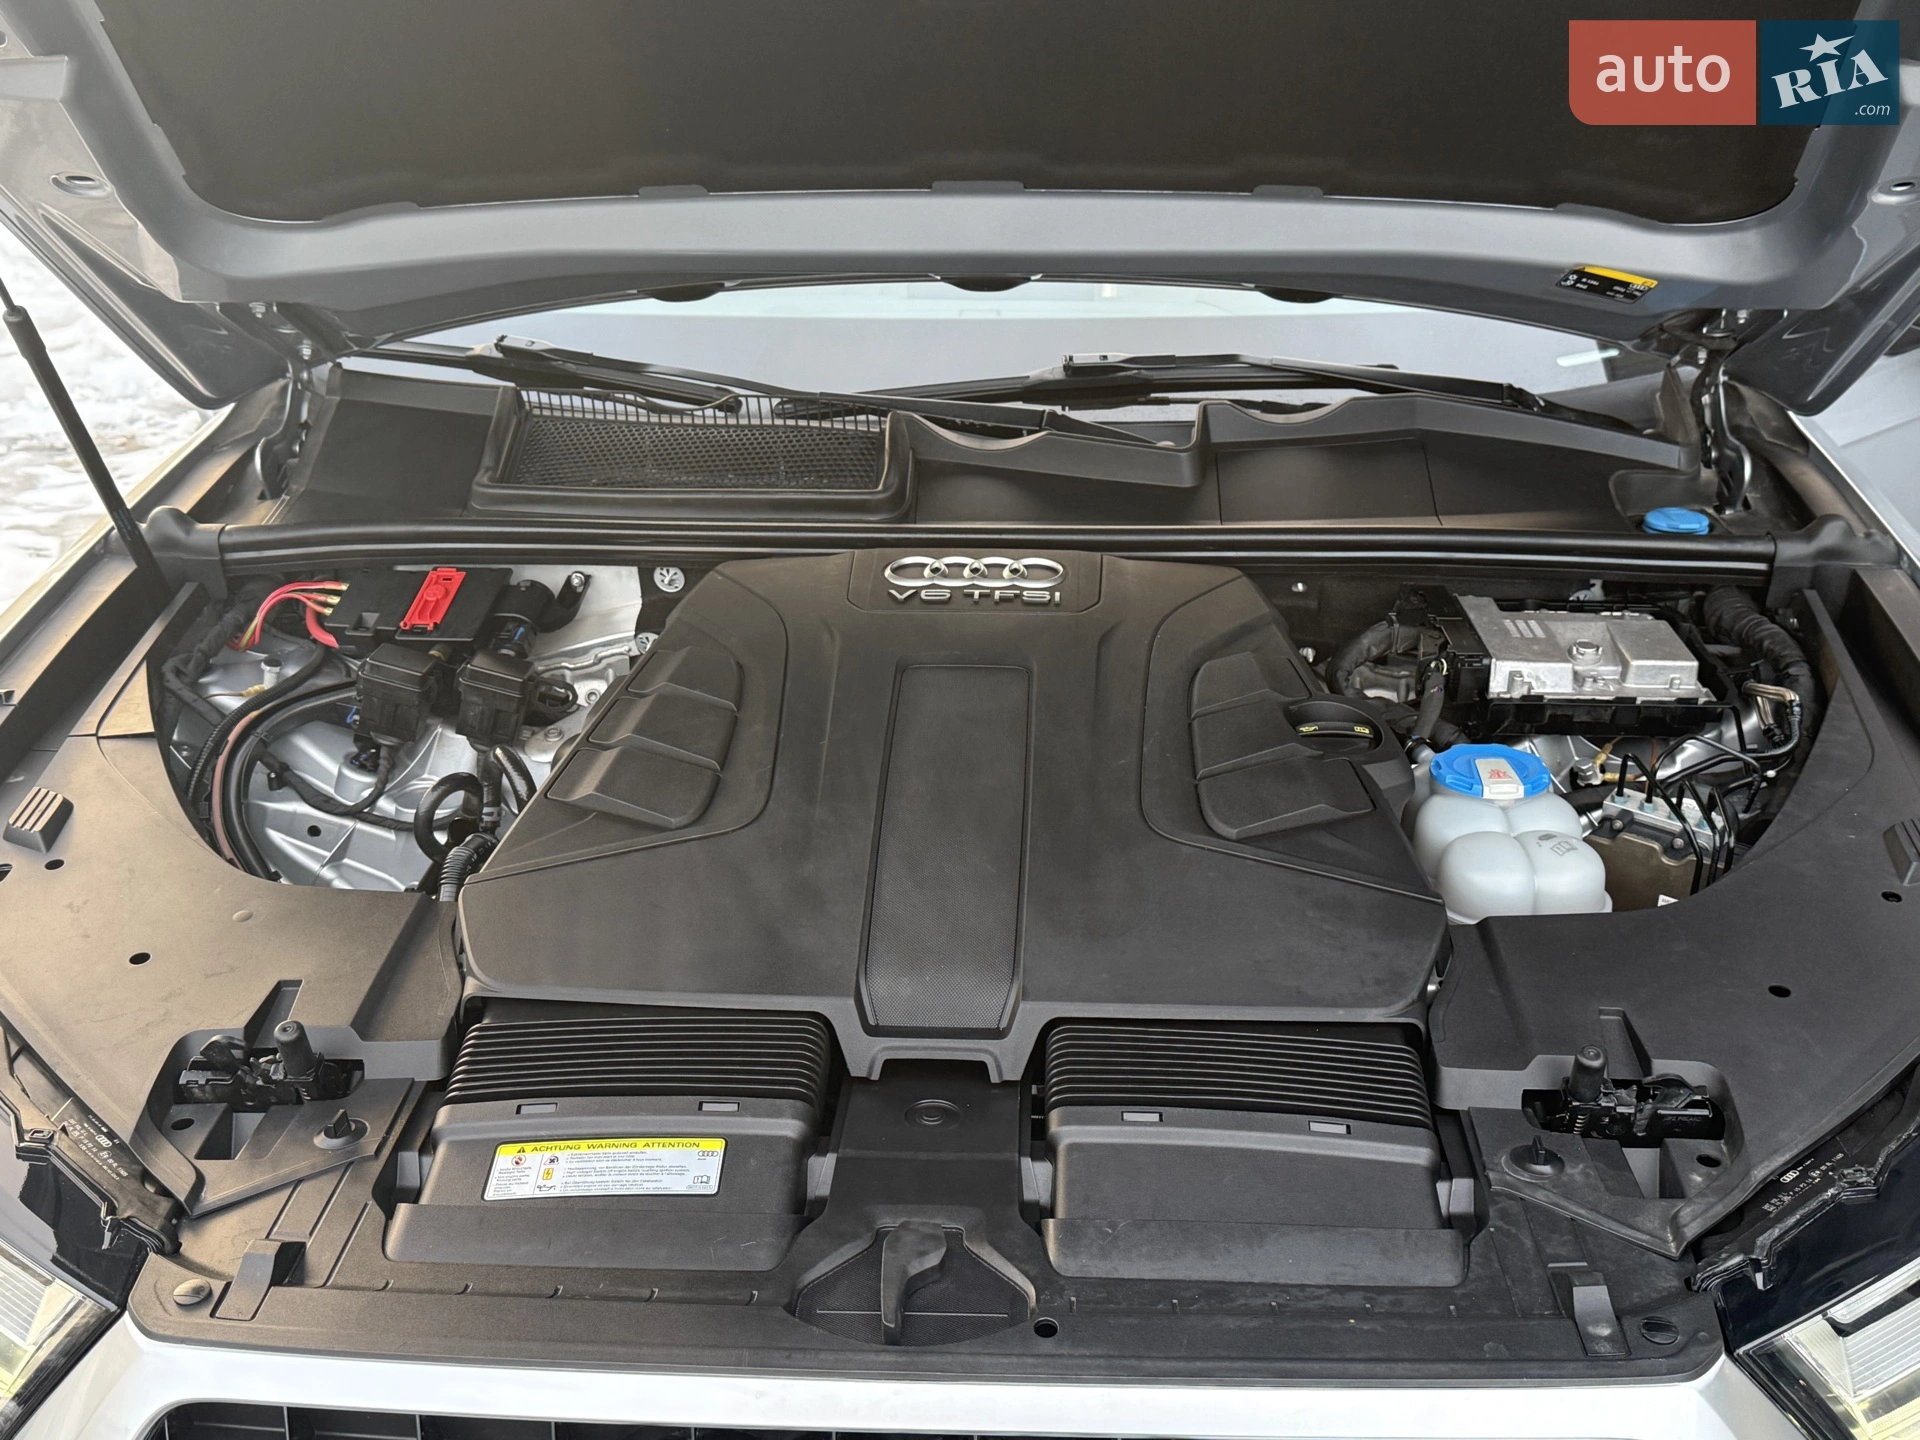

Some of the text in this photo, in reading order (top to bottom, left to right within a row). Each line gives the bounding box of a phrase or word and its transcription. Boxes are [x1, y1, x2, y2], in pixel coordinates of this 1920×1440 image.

[888, 588, 1061, 605] V6 TFSI
[531, 1141, 701, 1152] ACHTUNG WARNING ATTENTION
